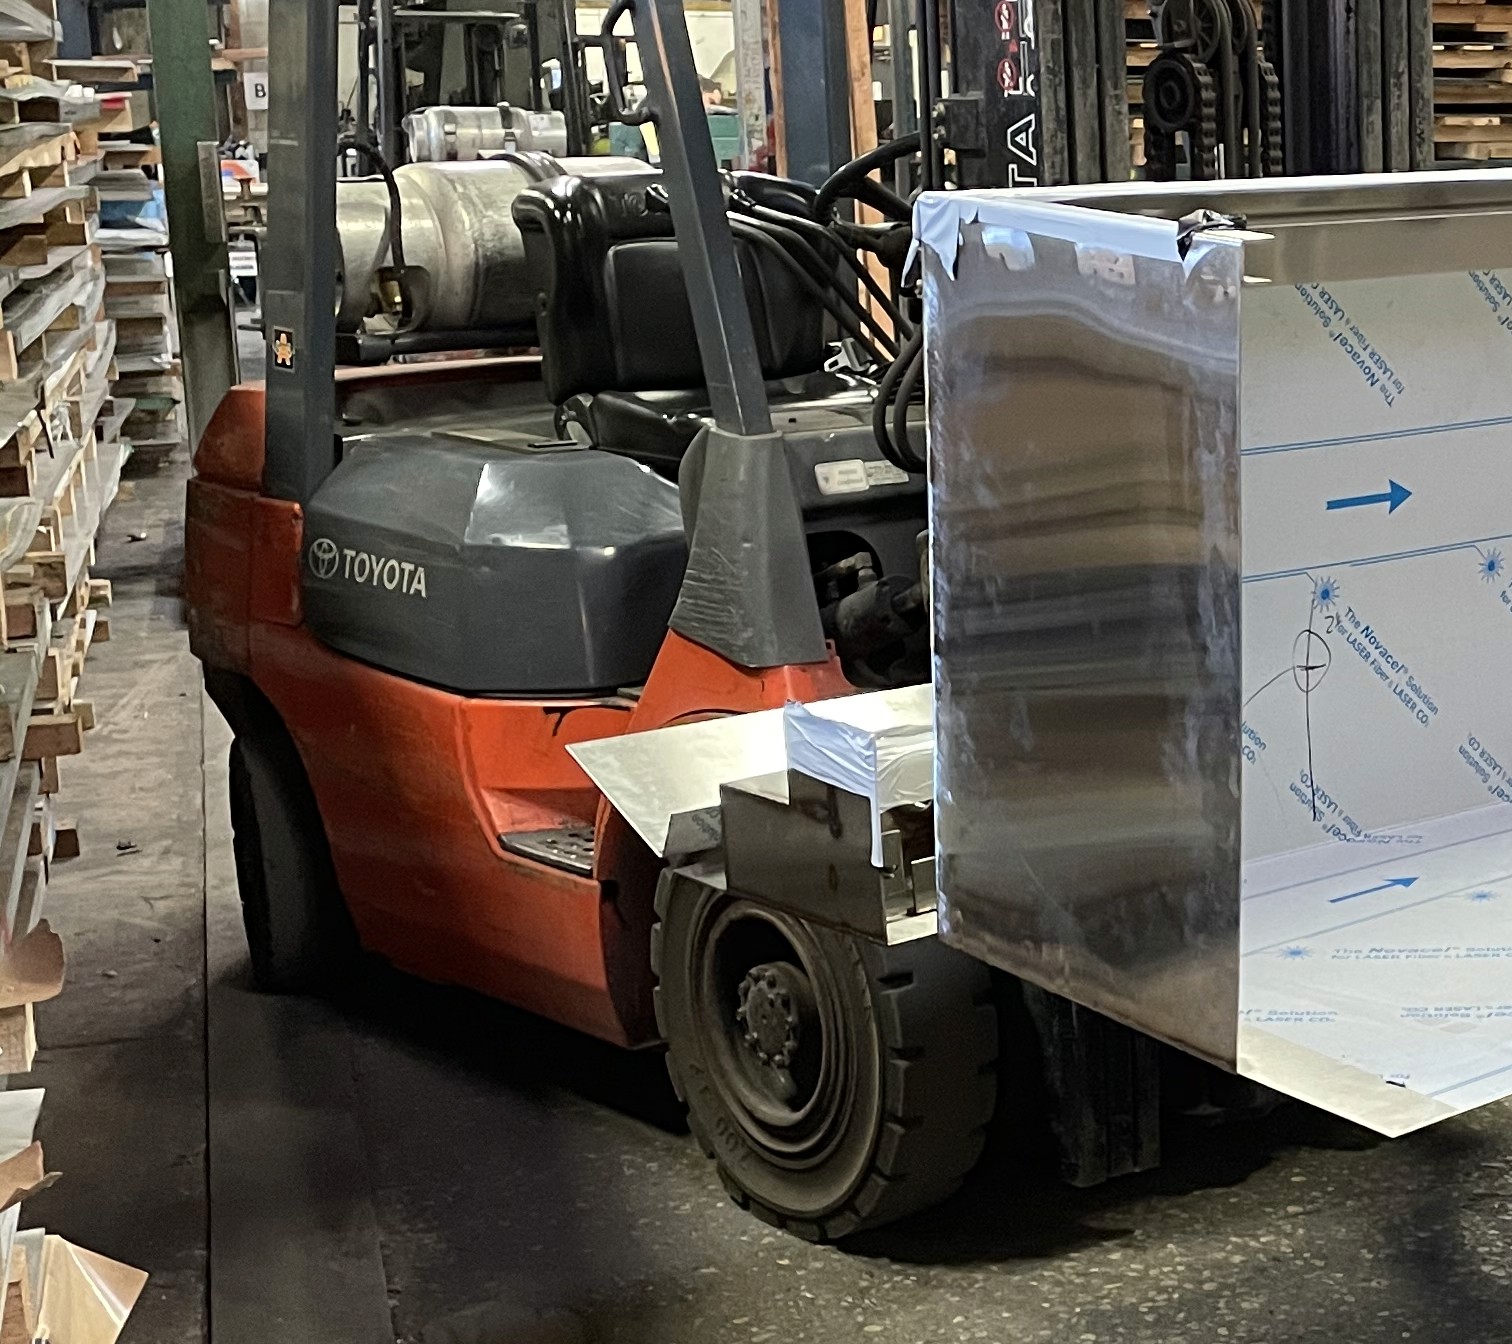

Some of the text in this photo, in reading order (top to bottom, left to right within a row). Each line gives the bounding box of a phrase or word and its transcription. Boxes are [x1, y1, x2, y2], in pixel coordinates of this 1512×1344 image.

[254, 83, 266, 98] B
[1318, 287, 1404, 394] for LASER Fiber LASER
[1379, 383, 1395, 407] The
[343, 548, 427, 598] TOYOTA
[1499, 589, 1511, 605] for
[1344, 606, 1360, 629] The
[1405, 675, 1438, 715] Solution
[1346, 632, 1371, 662] LASER
[1369, 657, 1389, 681] Fiber
[1392, 683, 1417, 712] LASER
